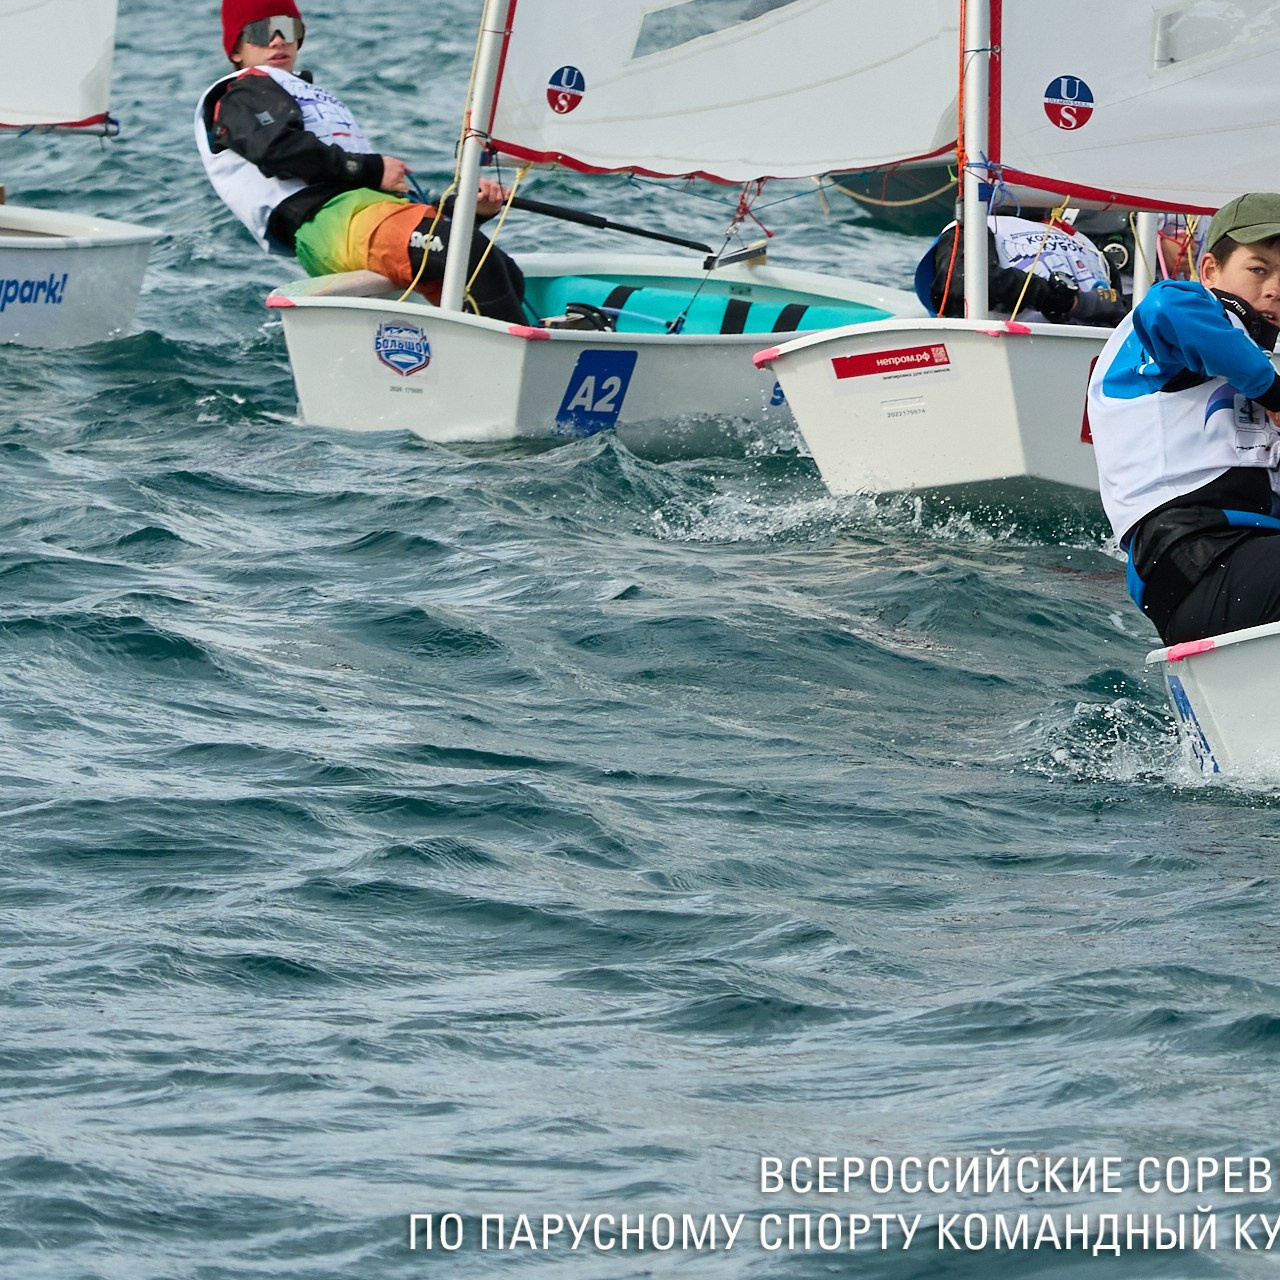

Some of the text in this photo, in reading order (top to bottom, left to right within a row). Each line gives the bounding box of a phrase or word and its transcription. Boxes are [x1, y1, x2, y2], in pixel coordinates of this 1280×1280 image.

[561, 68, 578, 88] U
[1060, 77, 1081, 100] U
[555, 92, 571, 113] S
[1059, 106, 1077, 129] S
[0, 273, 68, 312] park!
[876, 351, 931, 367] непром.рф
[566, 376, 621, 412] A2
